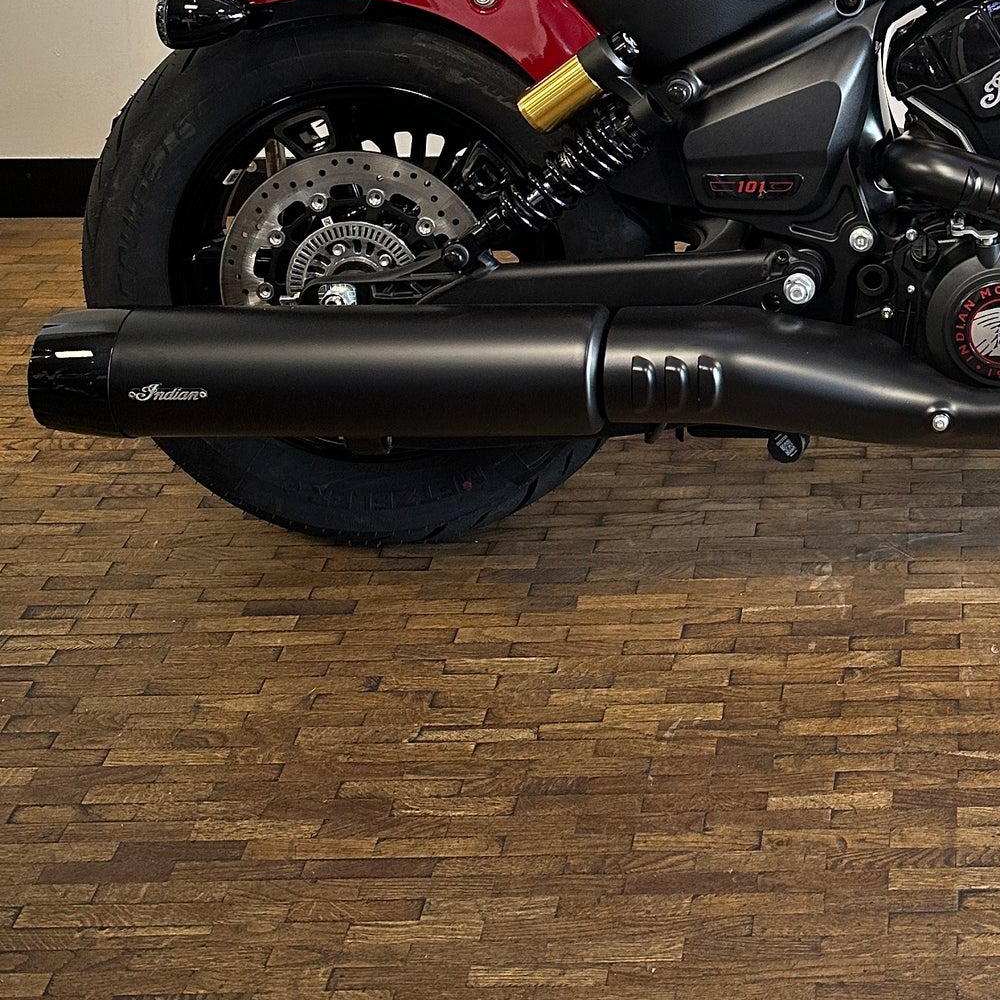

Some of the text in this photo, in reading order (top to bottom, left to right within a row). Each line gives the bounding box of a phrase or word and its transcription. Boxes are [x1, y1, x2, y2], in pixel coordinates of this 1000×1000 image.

[737, 180, 766, 194] 101
[955, 299, 976, 362] INDIAN
[132, 383, 202, 401] Indian
